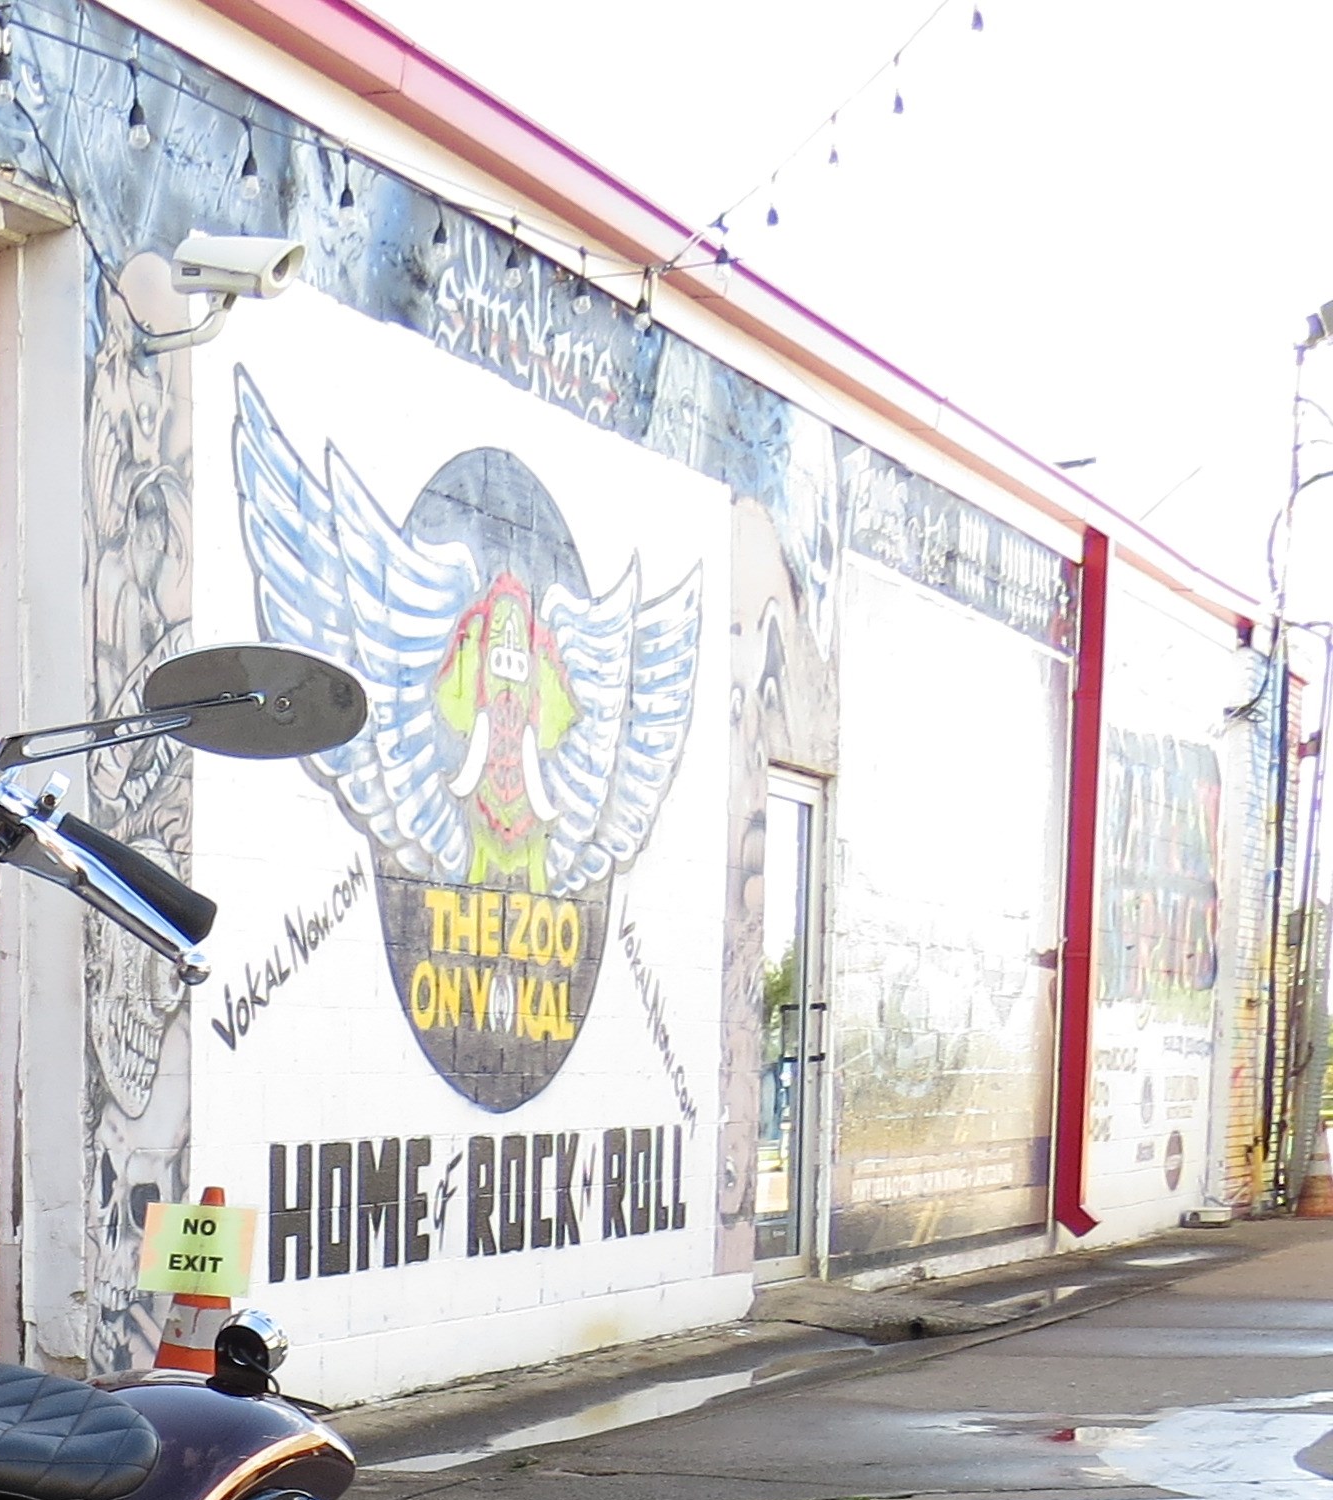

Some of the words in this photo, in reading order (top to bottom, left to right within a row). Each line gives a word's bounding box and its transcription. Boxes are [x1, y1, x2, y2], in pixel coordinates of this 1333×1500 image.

[424, 889, 501, 958] THE
[508, 892, 579, 968] ZOO
[410, 960, 462, 1030] ON
[182, 1218, 217, 1236] NO
[269, 1136, 431, 1284] HOME
[467, 1131, 581, 1258] ROCK
[603, 1124, 686, 1242] ROLL
[168, 1253, 224, 1274] EXIT
